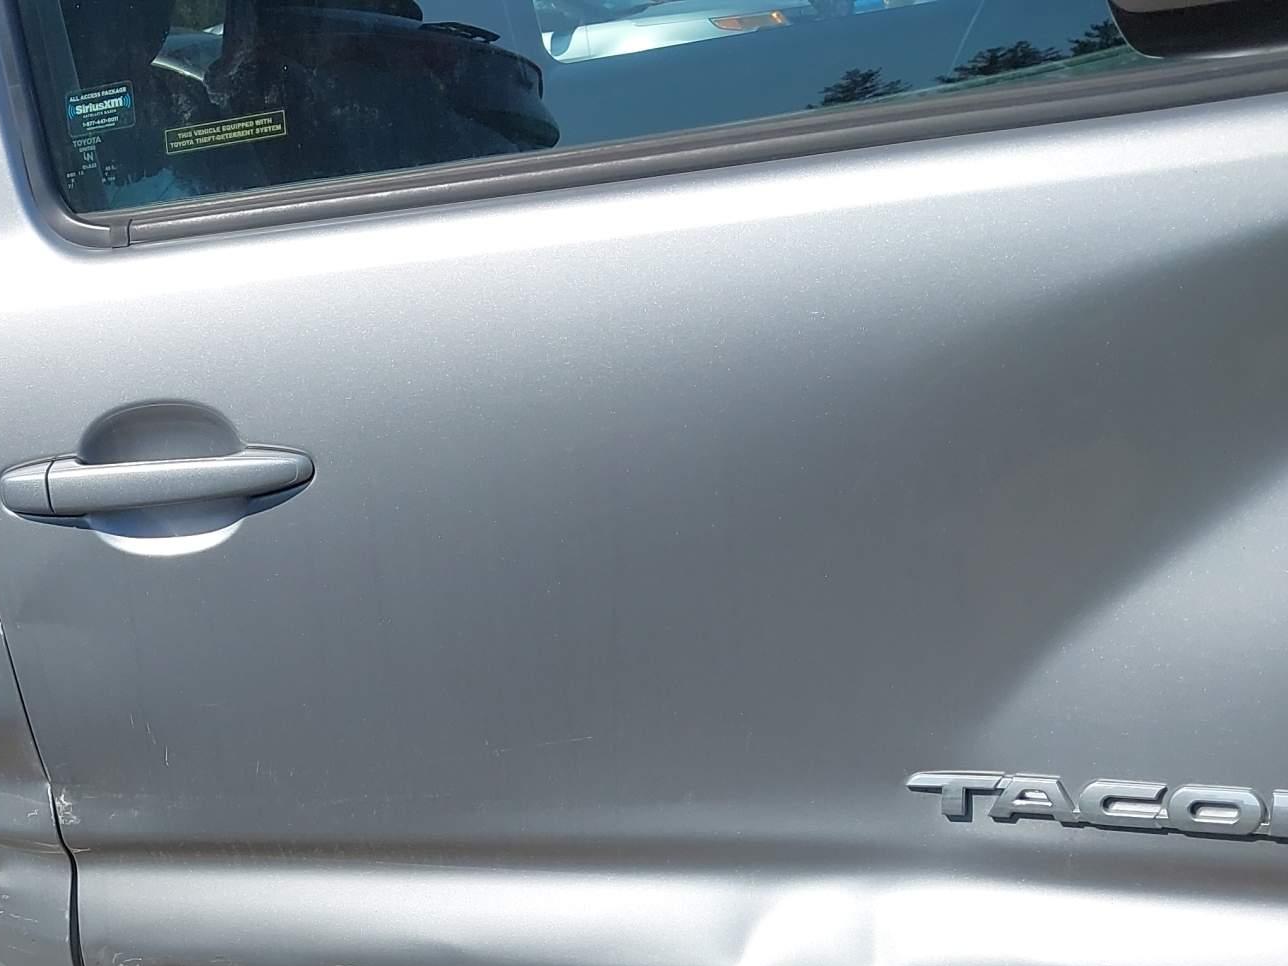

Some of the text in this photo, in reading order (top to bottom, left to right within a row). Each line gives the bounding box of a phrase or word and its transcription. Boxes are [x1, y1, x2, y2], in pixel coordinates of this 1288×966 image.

[170, 140, 194, 149] TOYOTA
[255, 124, 282, 134] SYSTEM
[177, 117, 272, 139] THIS VEHICLE EQUIPPED WITH
[72, 136, 102, 148] TOYOTA
[906, 769, 1288, 844] TACO
